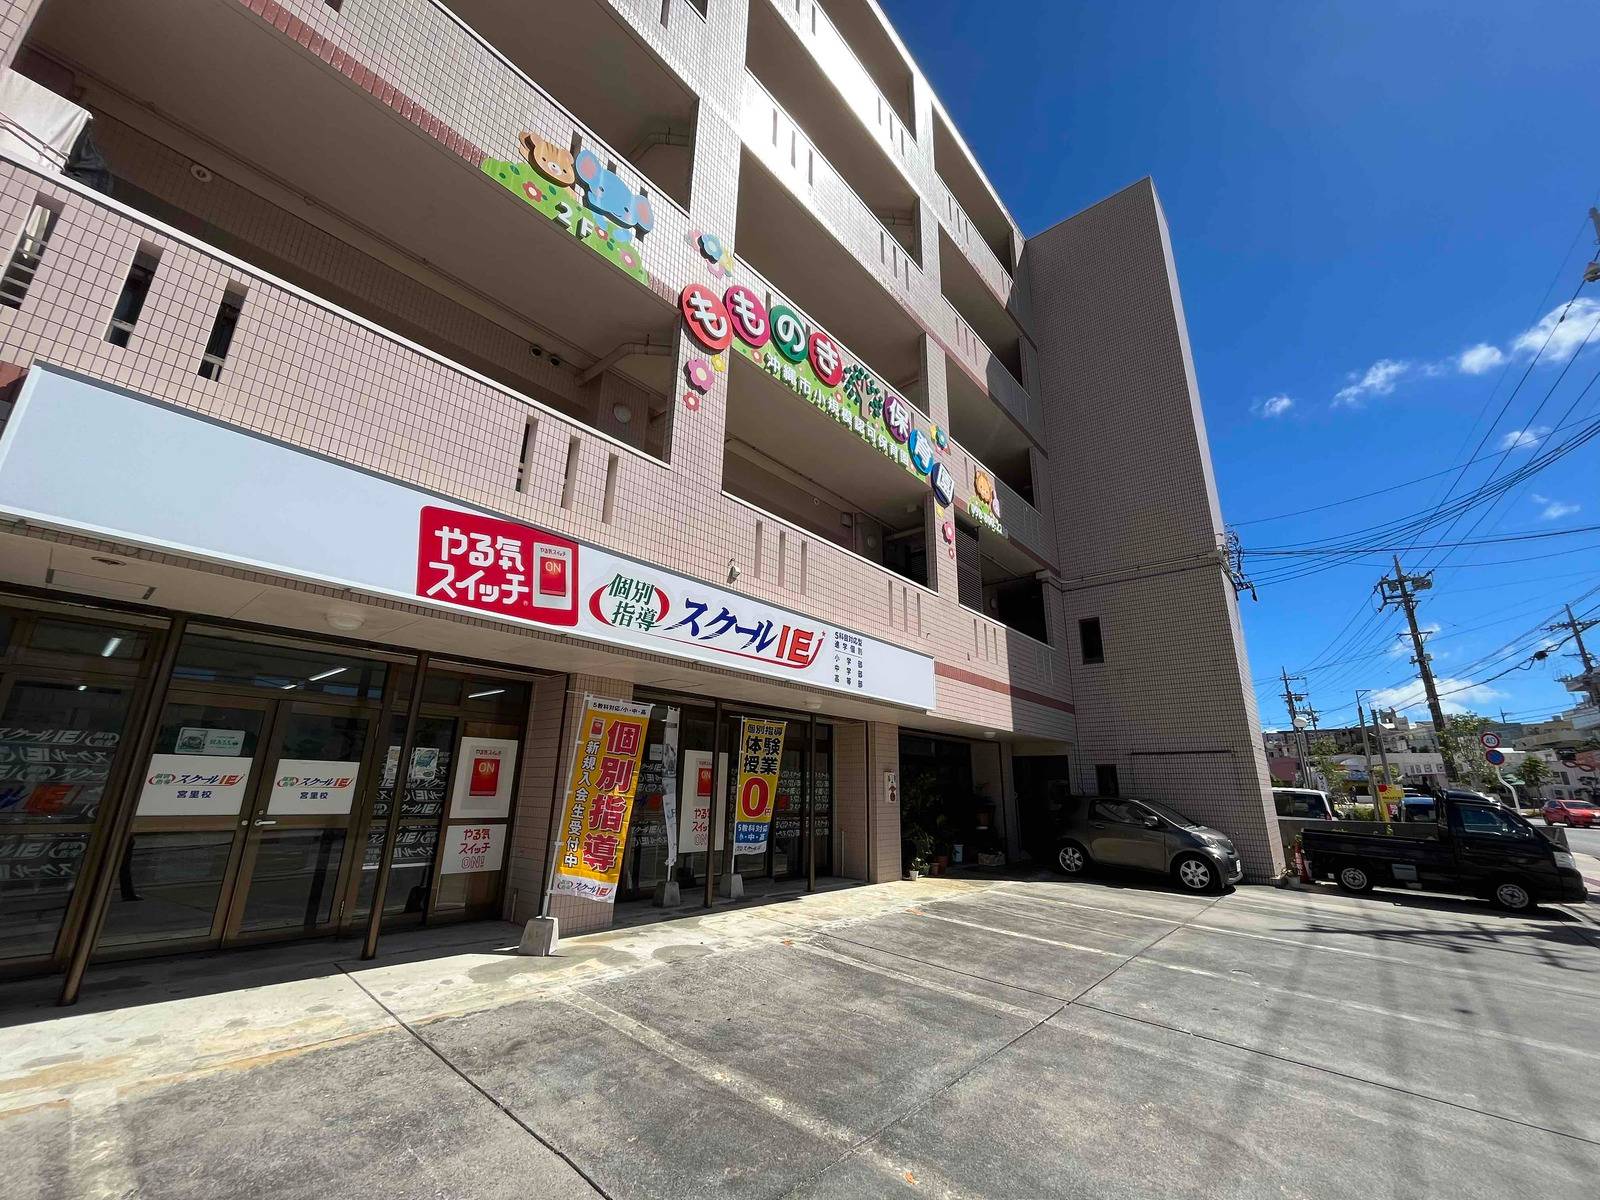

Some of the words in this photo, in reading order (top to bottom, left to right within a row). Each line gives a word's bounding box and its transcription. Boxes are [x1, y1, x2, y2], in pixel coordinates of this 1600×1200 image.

[556, 201, 595, 238] 2F
[435, 525, 524, 572] やる気
[545, 561, 562, 573] ON
[426, 562, 529, 604] スイッチ
[607, 573, 655, 606] 個別
[611, 600, 660, 631] 指導
[664, 598, 814, 664] スクールIE
[746, 736, 780, 755] 体験
[479, 762, 495, 773] ON
[744, 755, 777, 775] 授業
[176, 790, 212, 799] 宮里校
[564, 740, 600, 868] 新規入会生受付中
[582, 719, 642, 872] 個別指導
[458, 842, 491, 854] スイッチ
[464, 829, 490, 840] やる気
